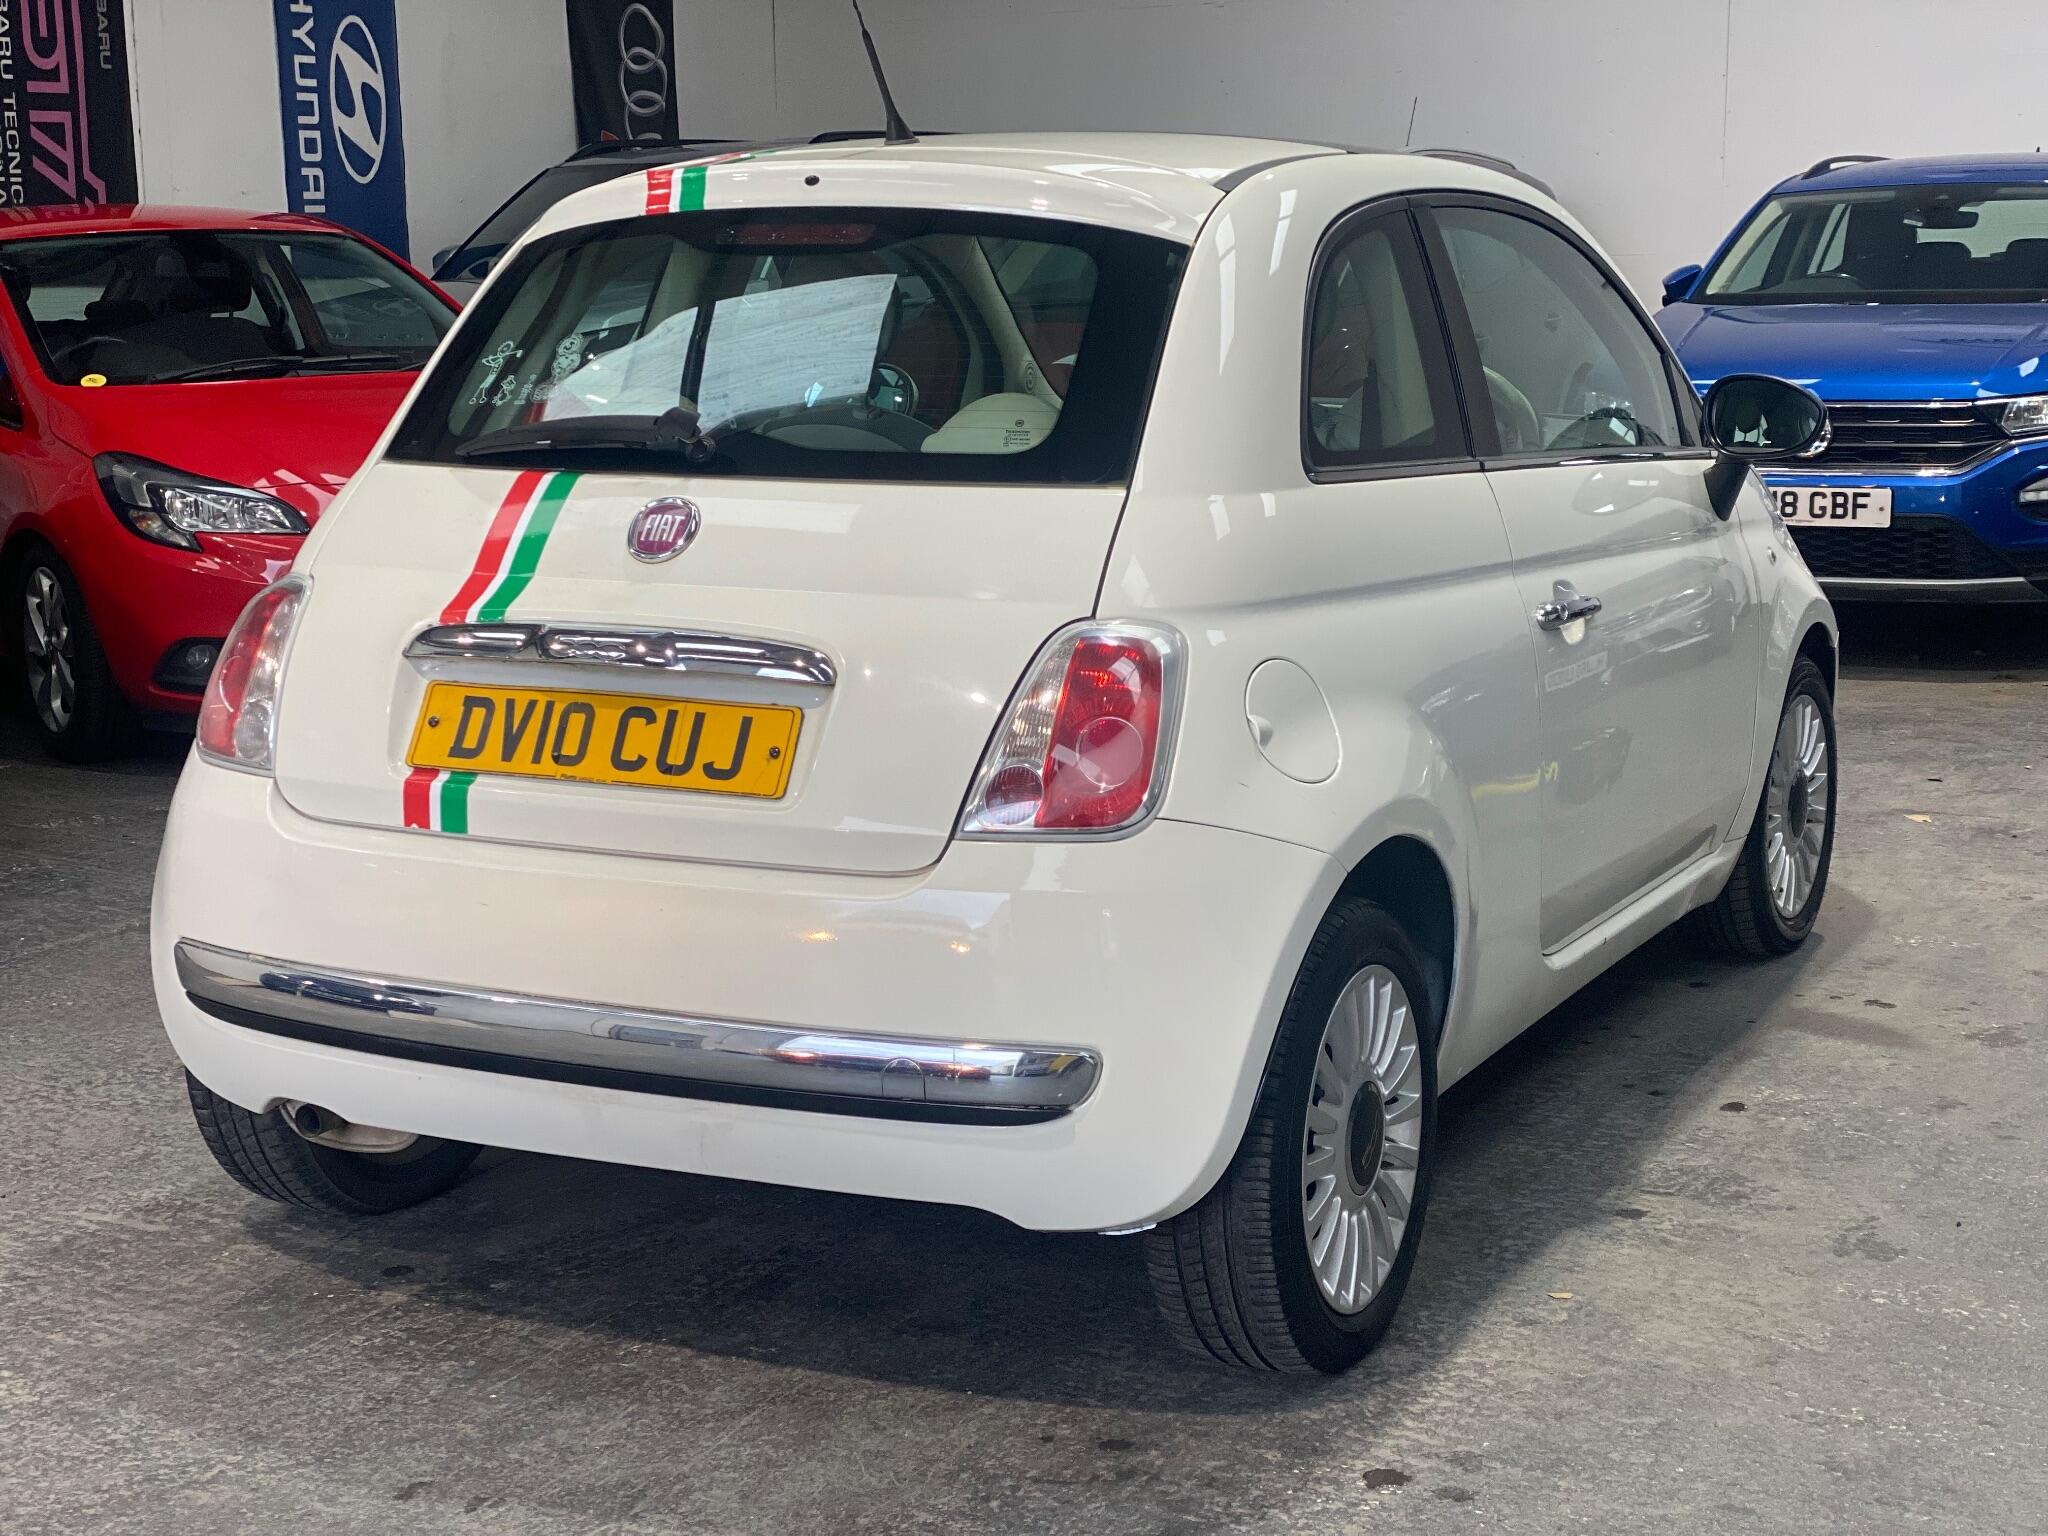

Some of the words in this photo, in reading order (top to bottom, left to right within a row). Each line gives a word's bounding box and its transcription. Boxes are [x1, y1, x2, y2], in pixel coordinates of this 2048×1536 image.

[3, 92, 24, 204] TECNIC
[640, 514, 685, 542] FIAT
[1809, 491, 1871, 519] GBF
[448, 695, 596, 767] DV10
[609, 706, 753, 780] CUJ
